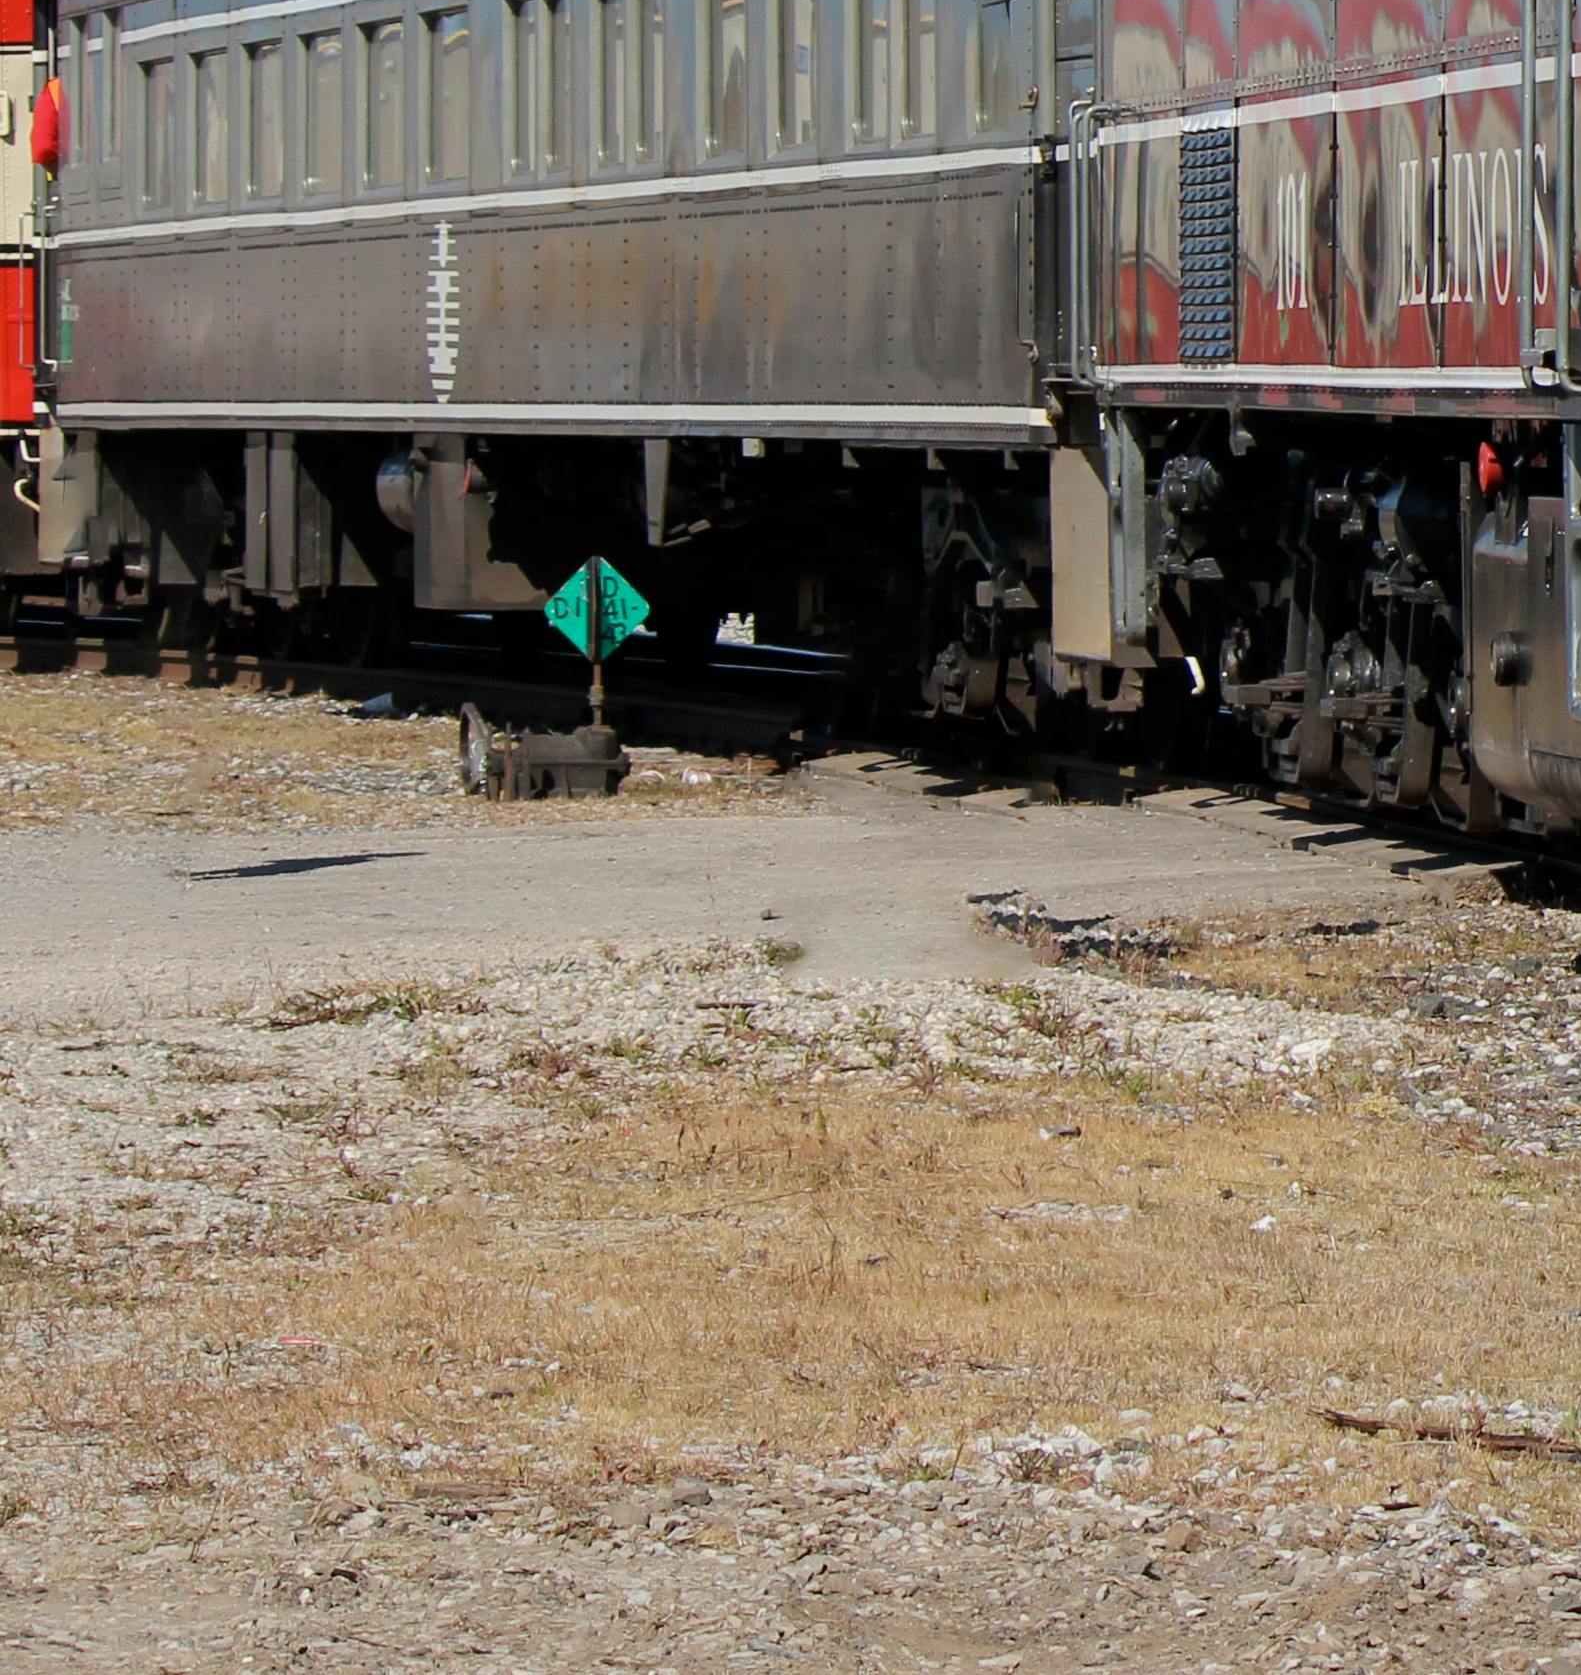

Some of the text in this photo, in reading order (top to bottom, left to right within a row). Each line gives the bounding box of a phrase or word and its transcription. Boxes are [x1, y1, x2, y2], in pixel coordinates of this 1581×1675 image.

[1275, 171, 1309, 311] 101
[1398, 142, 1550, 308] ILLINOIS
[602, 576, 619, 598] D
